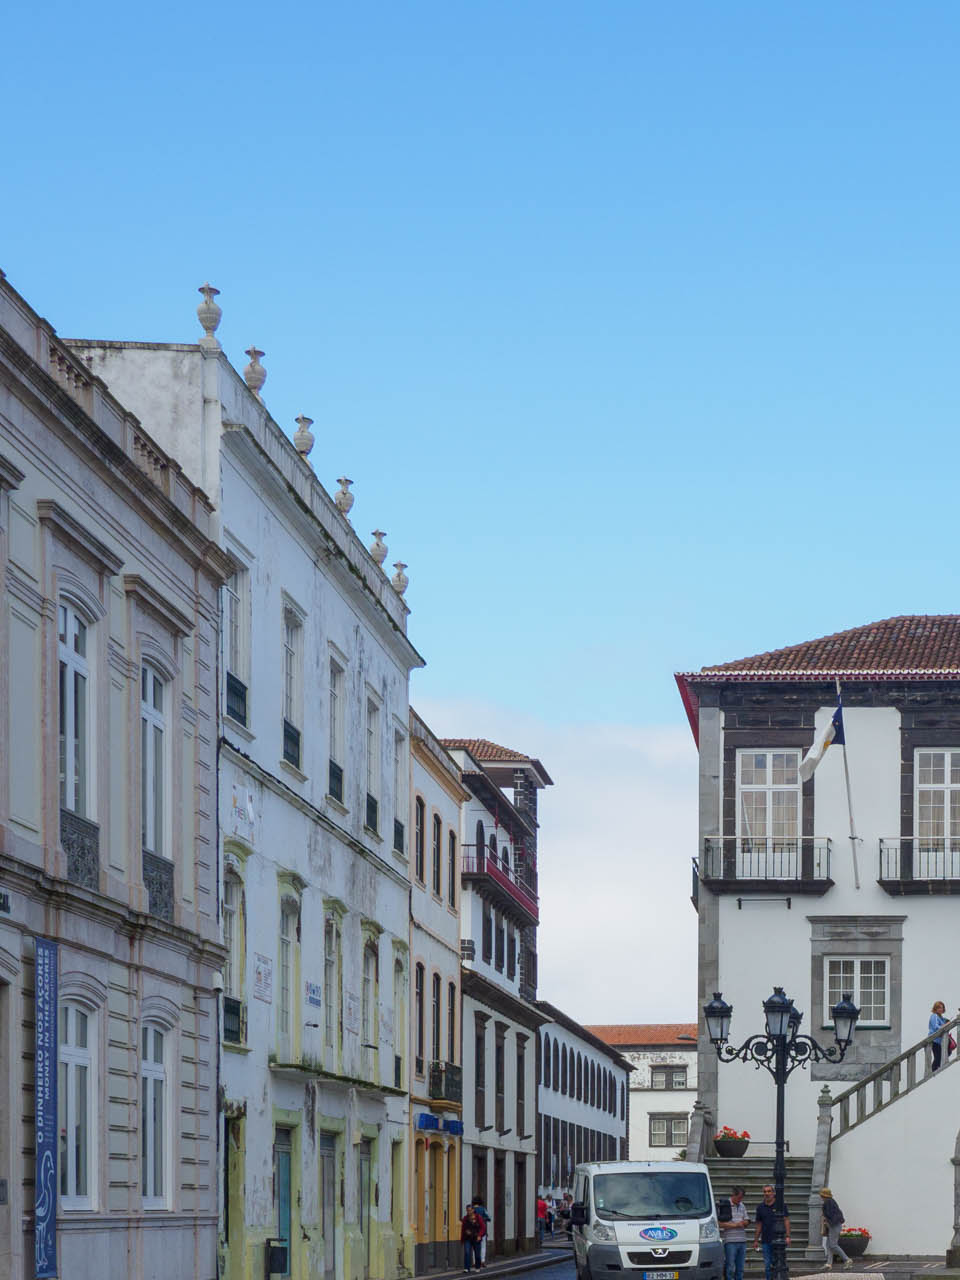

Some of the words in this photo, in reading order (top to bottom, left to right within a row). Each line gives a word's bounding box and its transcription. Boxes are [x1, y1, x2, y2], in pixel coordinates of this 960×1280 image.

[37, 947, 45, 1009] AÇORES
[44, 1032, 50, 1047] IN
[37, 1132, 44, 1143] O
[647, 1230, 671, 1238] AVLIS
